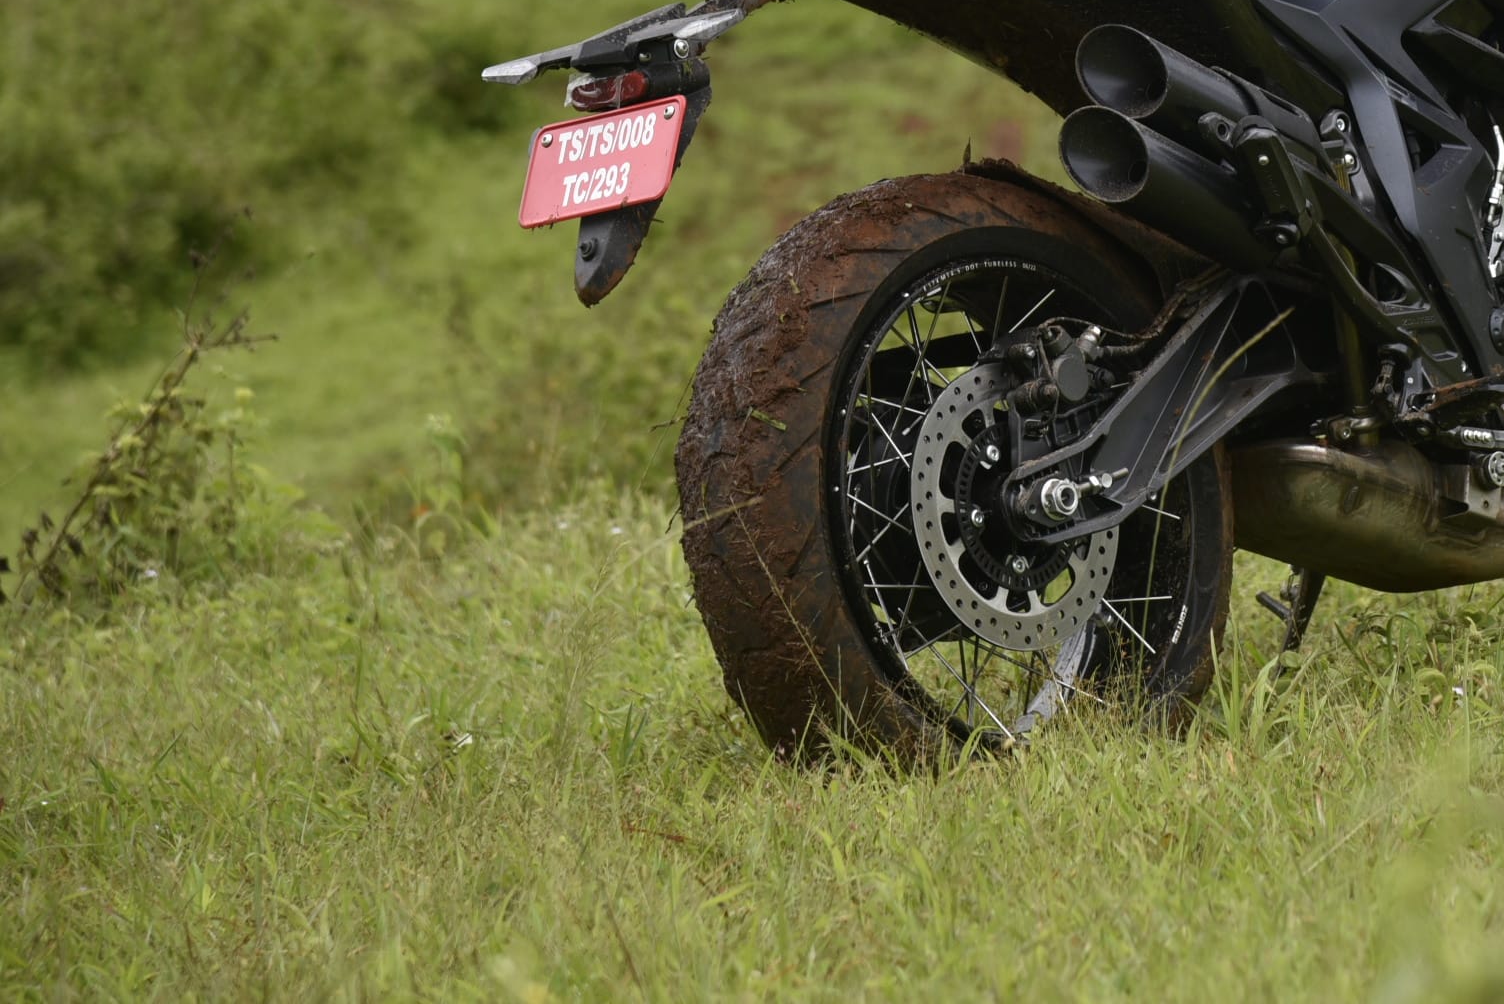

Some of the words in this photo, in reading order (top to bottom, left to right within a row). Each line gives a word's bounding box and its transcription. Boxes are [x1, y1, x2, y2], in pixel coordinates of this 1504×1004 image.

[558, 112, 656, 164] TS/TS/008
[562, 162, 630, 208] TC/293
[983, 259, 1017, 269] TUBELESS
